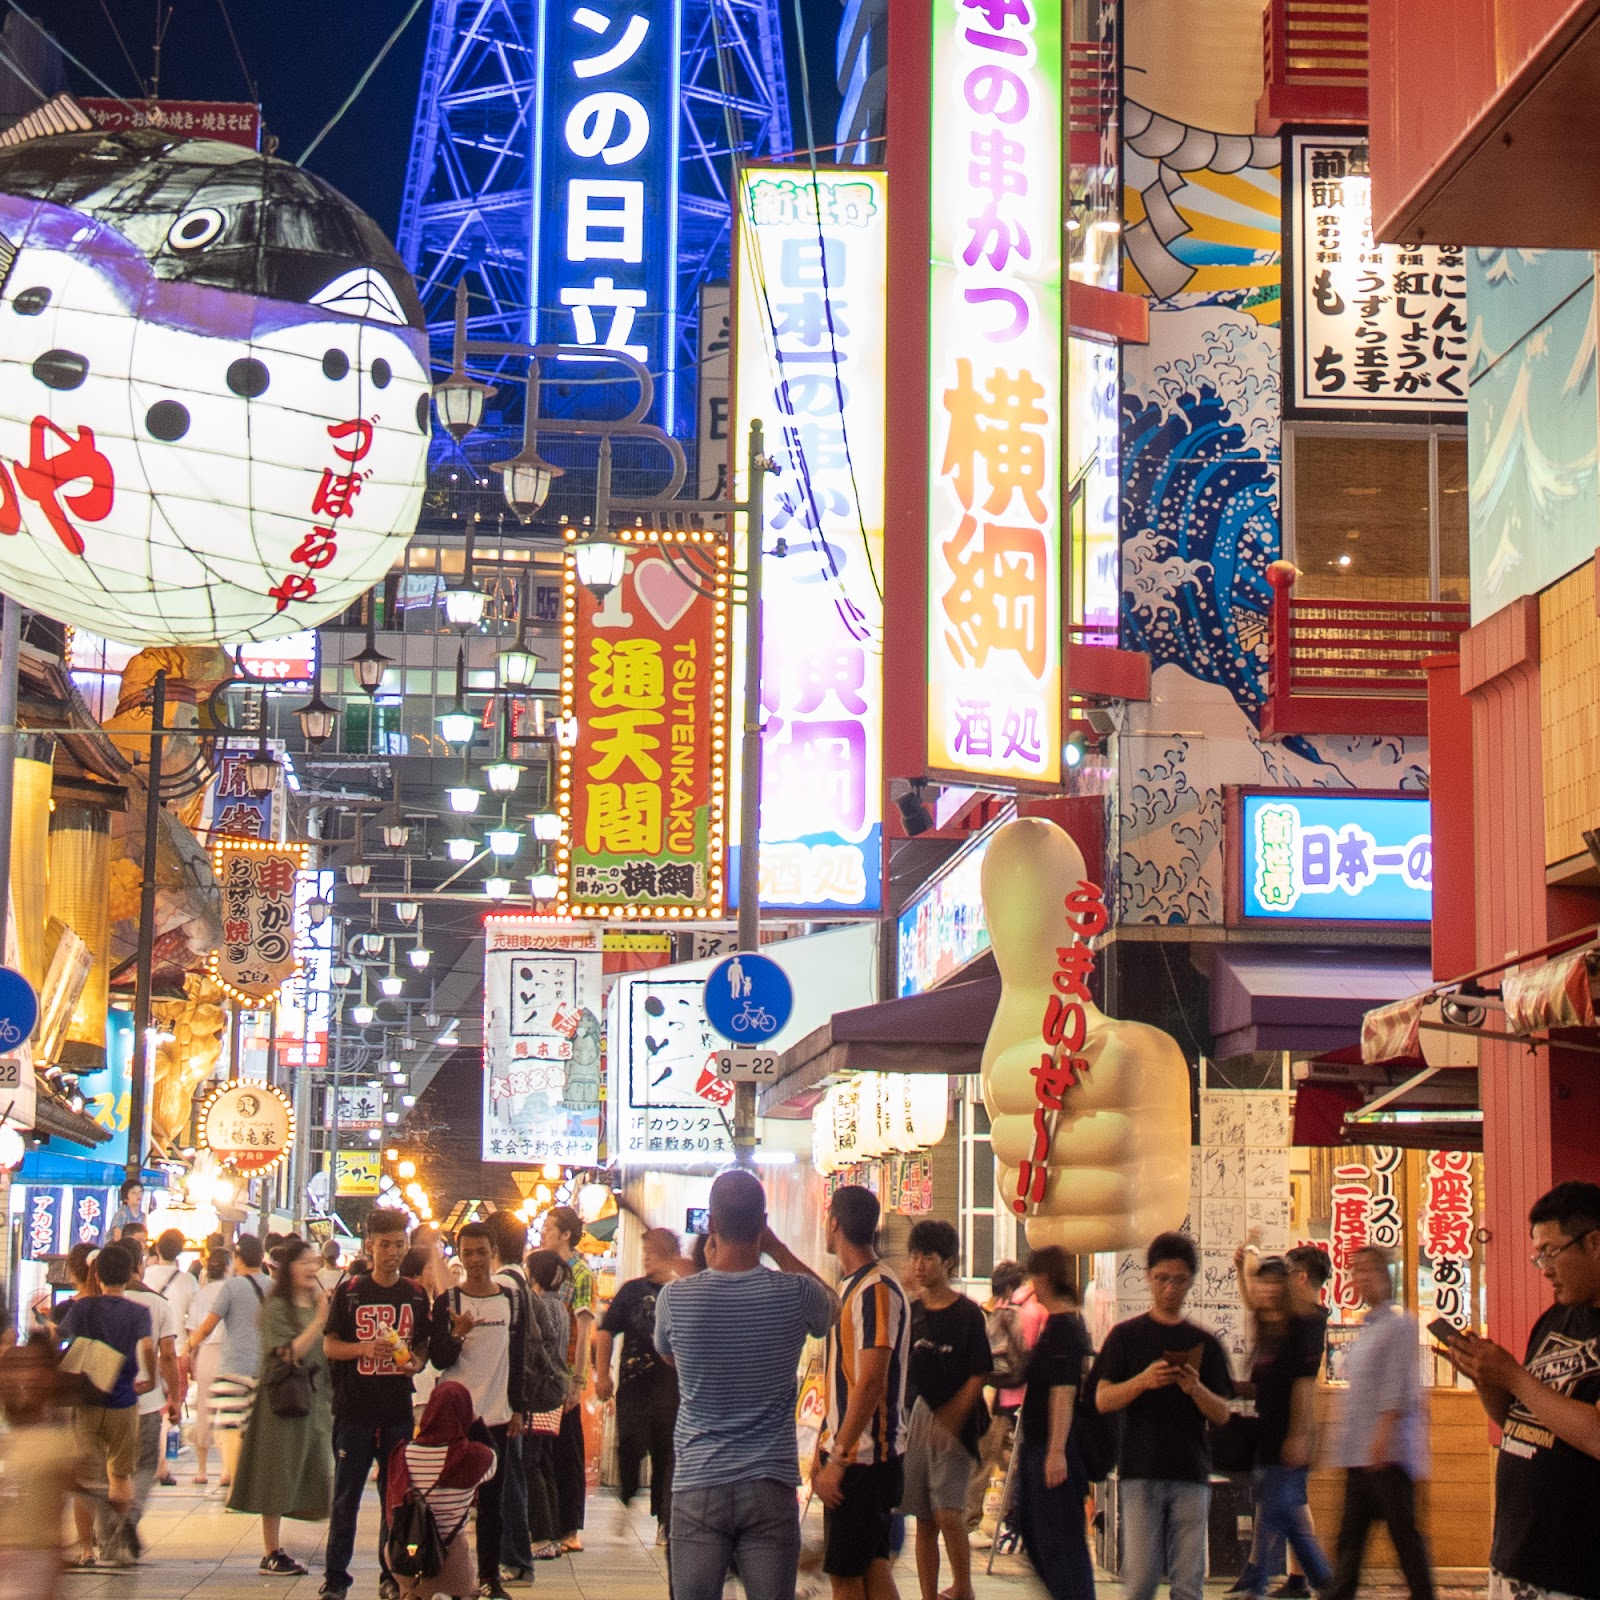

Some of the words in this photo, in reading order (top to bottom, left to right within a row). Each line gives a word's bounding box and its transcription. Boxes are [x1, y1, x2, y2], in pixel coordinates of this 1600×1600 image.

[750, 180, 877, 228] 新世界
[1352, 270, 1393, 394] うずら玉子
[1393, 272, 1431, 394] 紅しょうが
[1432, 273, 1468, 396] にんにく
[267, 412, 382, 612] づぼらや
[942, 357, 1049, 681] 横綱
[584, 637, 667, 854] 通天閣
[669, 637, 697, 852] TSUTENKAKU
[953, 696, 1042, 763] 酒処
[224, 857, 251, 963] お好み焼き
[255, 857, 296, 962] 串かつ
[575, 866, 619, 878] 日本一の
[620, 862, 696, 899] 横綱
[575, 881, 618, 896] 串かつ
[1260, 809, 1294, 906] 新世界
[493, 934, 597, 950] 元祖串カツ専門店
[329, 1154, 377, 1183] 串かつ
[491, 1139, 593, 1156] 宴会予約受付中
